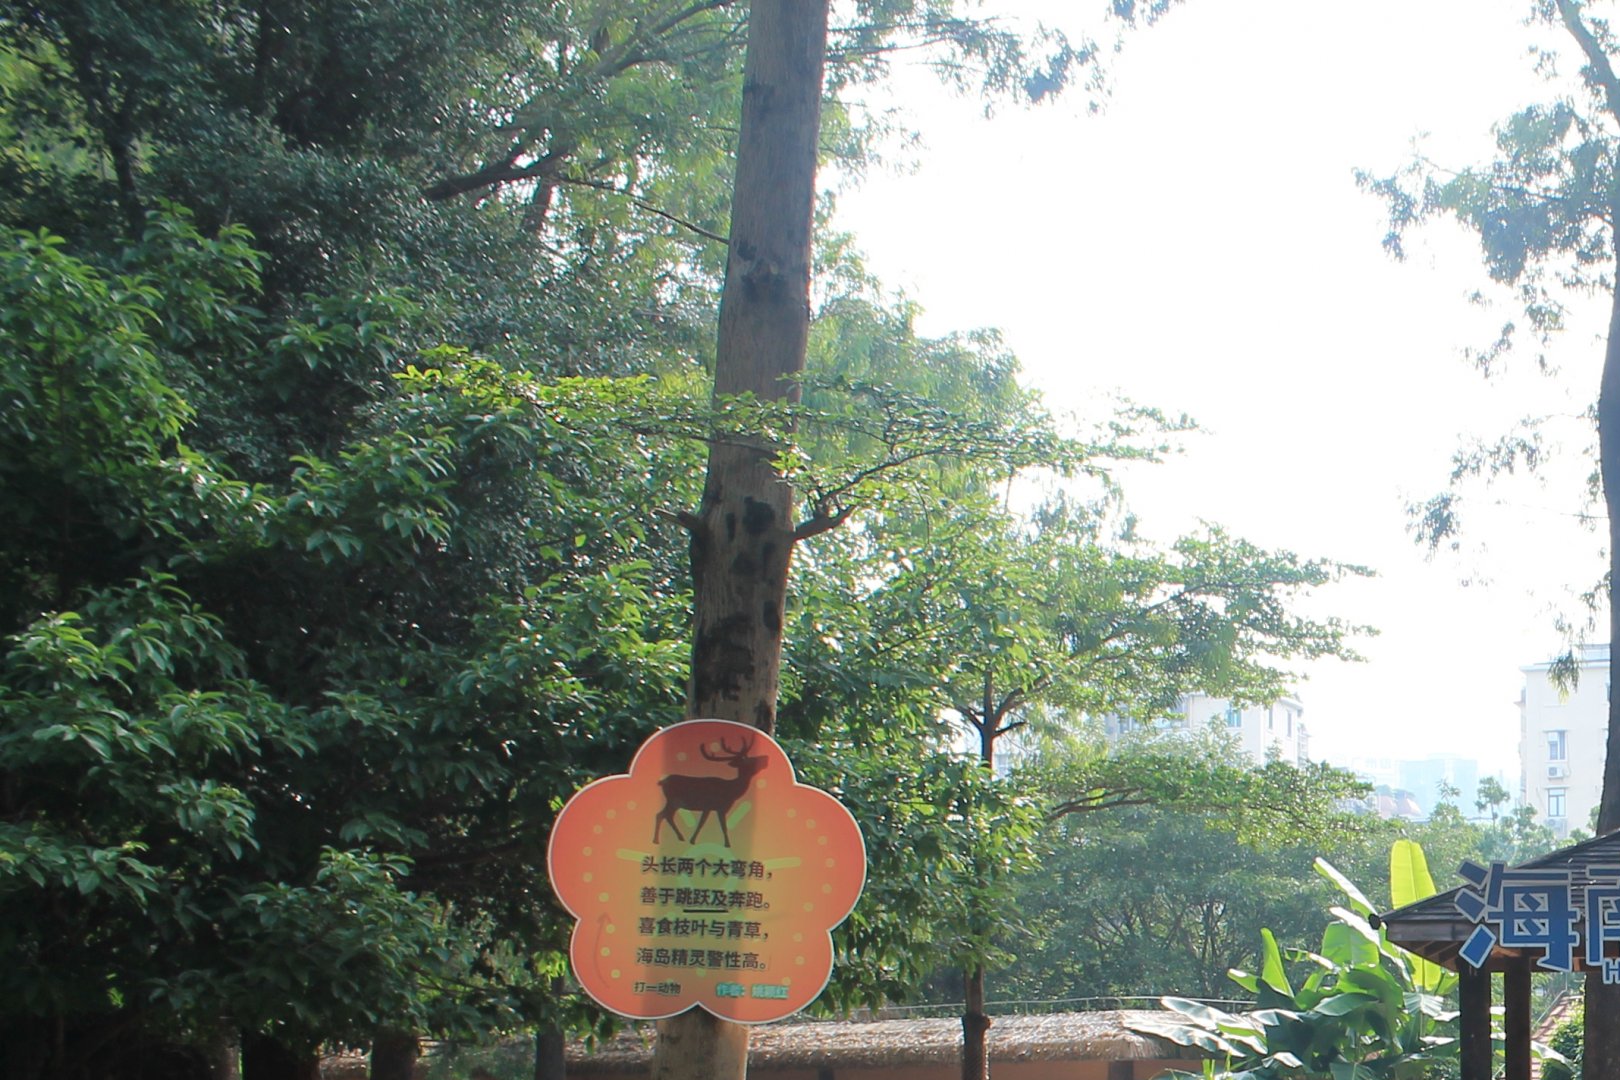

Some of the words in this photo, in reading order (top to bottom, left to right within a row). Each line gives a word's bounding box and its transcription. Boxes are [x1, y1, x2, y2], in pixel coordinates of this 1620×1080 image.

[640, 887, 770, 909] 善于跳跃及奔跑。
[636, 947, 767, 970] 海岛精灵警性高。
[634, 981, 681, 995] 打一动物
